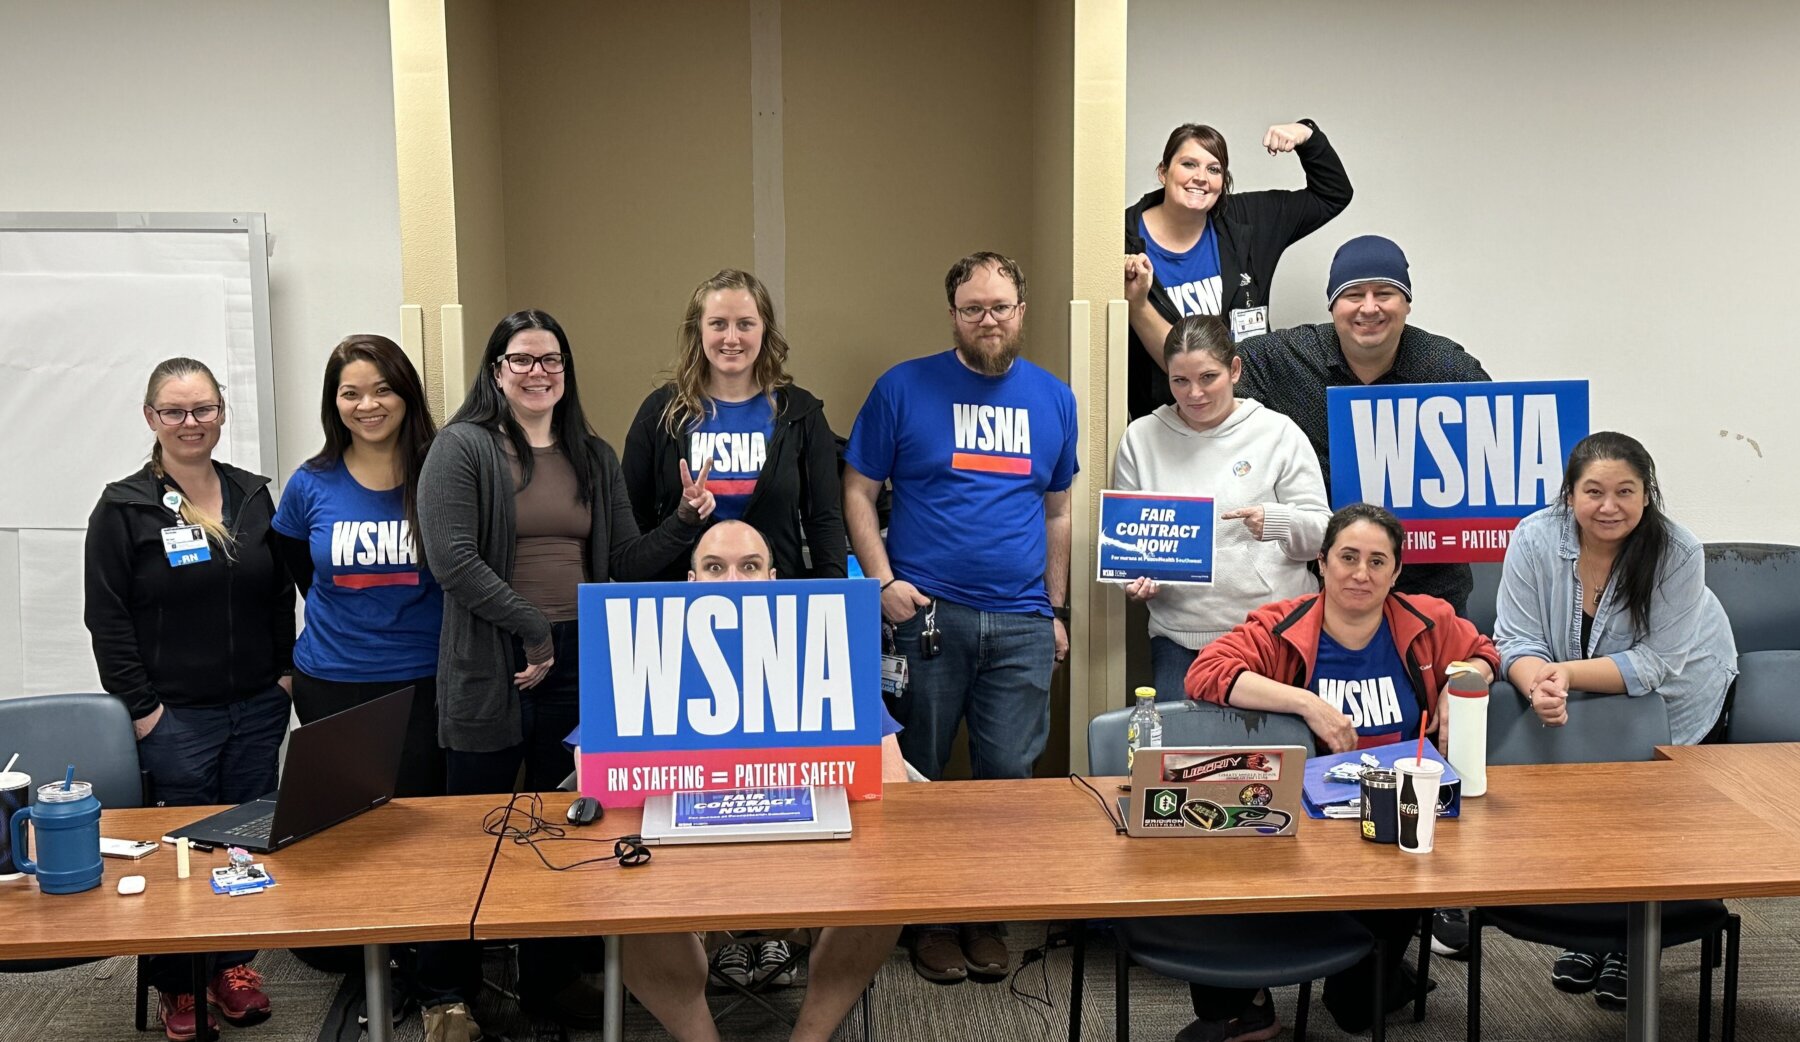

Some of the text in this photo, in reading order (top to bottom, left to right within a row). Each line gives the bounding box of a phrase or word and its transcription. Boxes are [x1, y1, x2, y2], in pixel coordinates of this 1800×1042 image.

[953, 404, 1031, 454] WSNA
[691, 432, 767, 473] WSNA
[1350, 393, 1564, 508] WSNA
[1116, 522, 1200, 538] CONTRACT
[1140, 508, 1176, 522] FAIR
[182, 553, 198, 563] RN
[332, 520, 418, 566] WSNA
[1136, 538, 1179, 553] NOW!
[605, 594, 856, 736] WSNA
[1318, 676, 1403, 728] WSNA
[608, 761, 856, 791] RN STAFFING = PATIENT SAFETY
[693, 797, 796, 810] CONTRACT
[723, 793, 765, 801] FAIR
